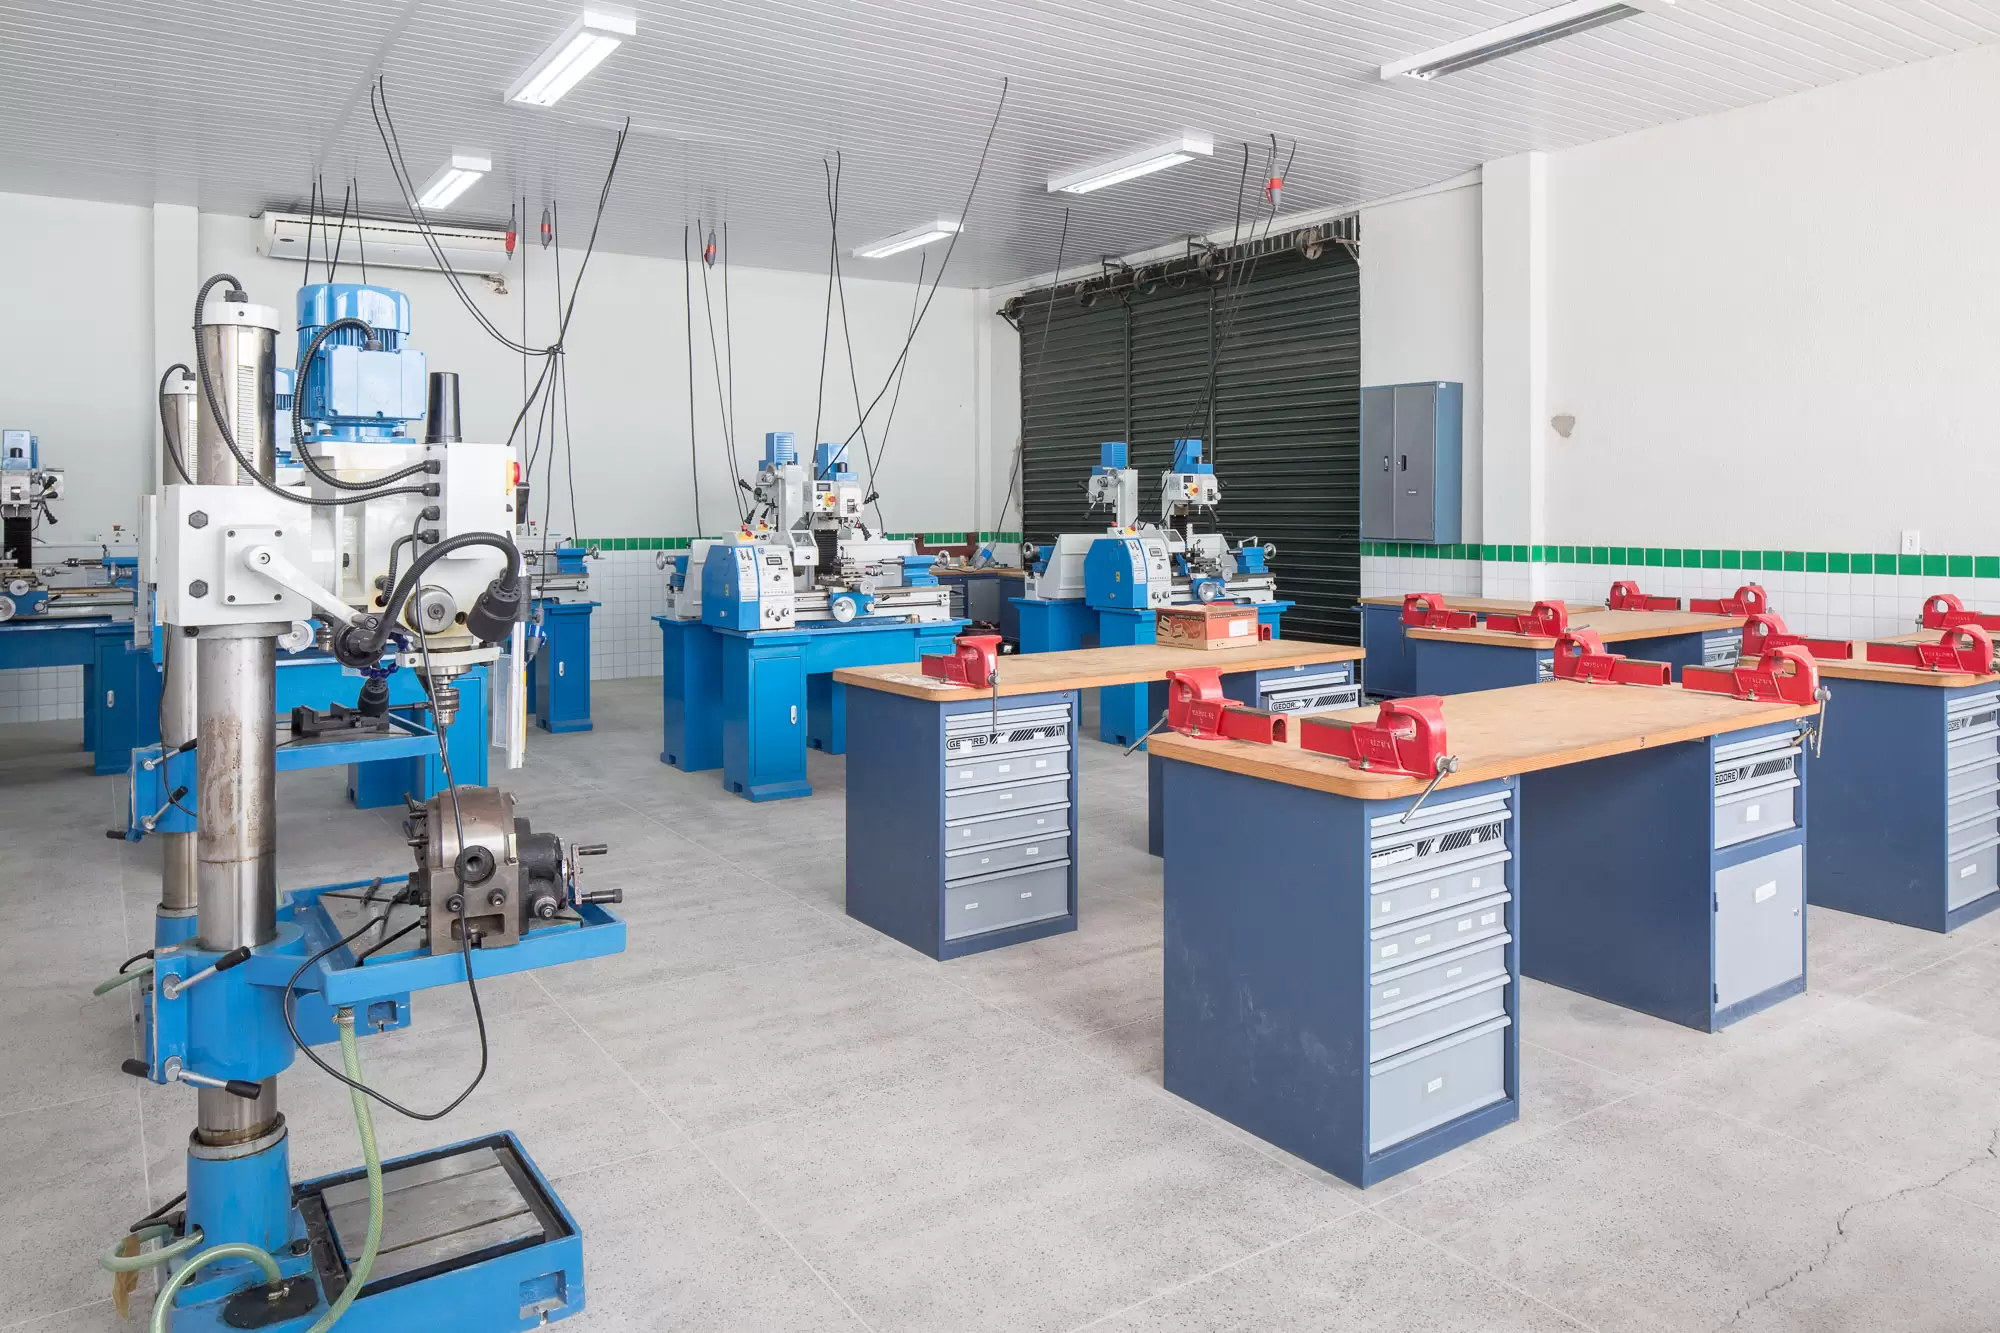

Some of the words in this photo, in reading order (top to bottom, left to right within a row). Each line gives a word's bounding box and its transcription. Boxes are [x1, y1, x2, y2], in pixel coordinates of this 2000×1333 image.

[1273, 701, 1298, 711] GEDOR
[949, 737, 985, 748] GERE
[1715, 771, 1736, 784] EDORE
